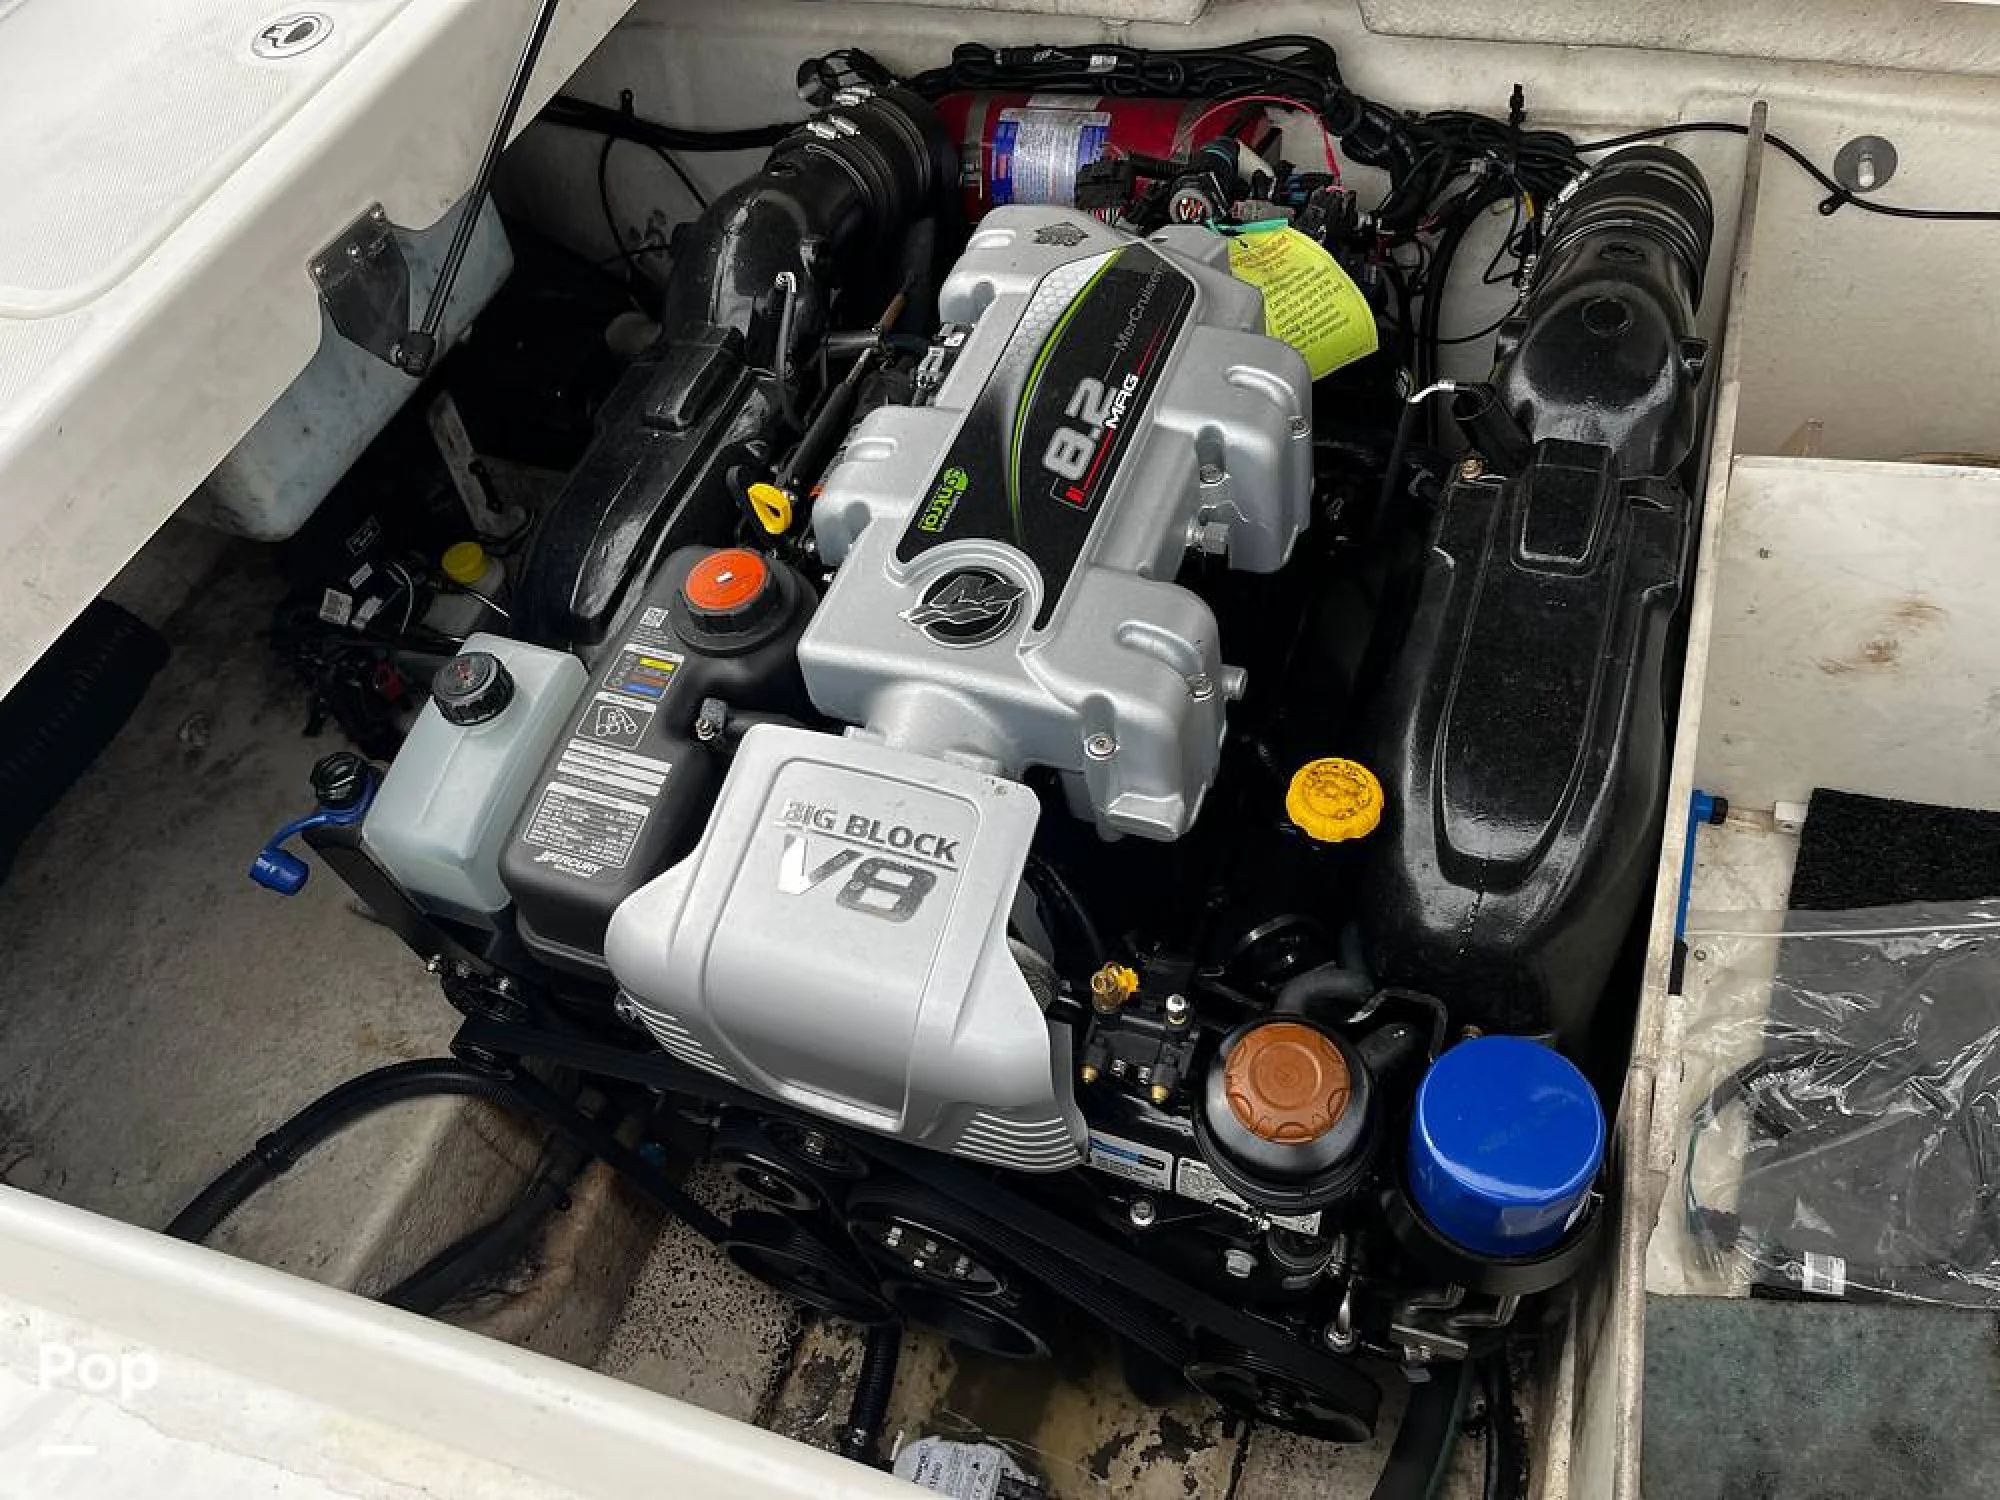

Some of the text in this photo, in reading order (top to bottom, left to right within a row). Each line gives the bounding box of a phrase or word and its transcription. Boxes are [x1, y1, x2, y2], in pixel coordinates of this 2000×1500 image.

[1042, 377, 1118, 480] 8.2
[1104, 373, 1138, 429] MAG
[783, 800, 960, 863] BIG BLOCK
[777, 833, 938, 923] V8
